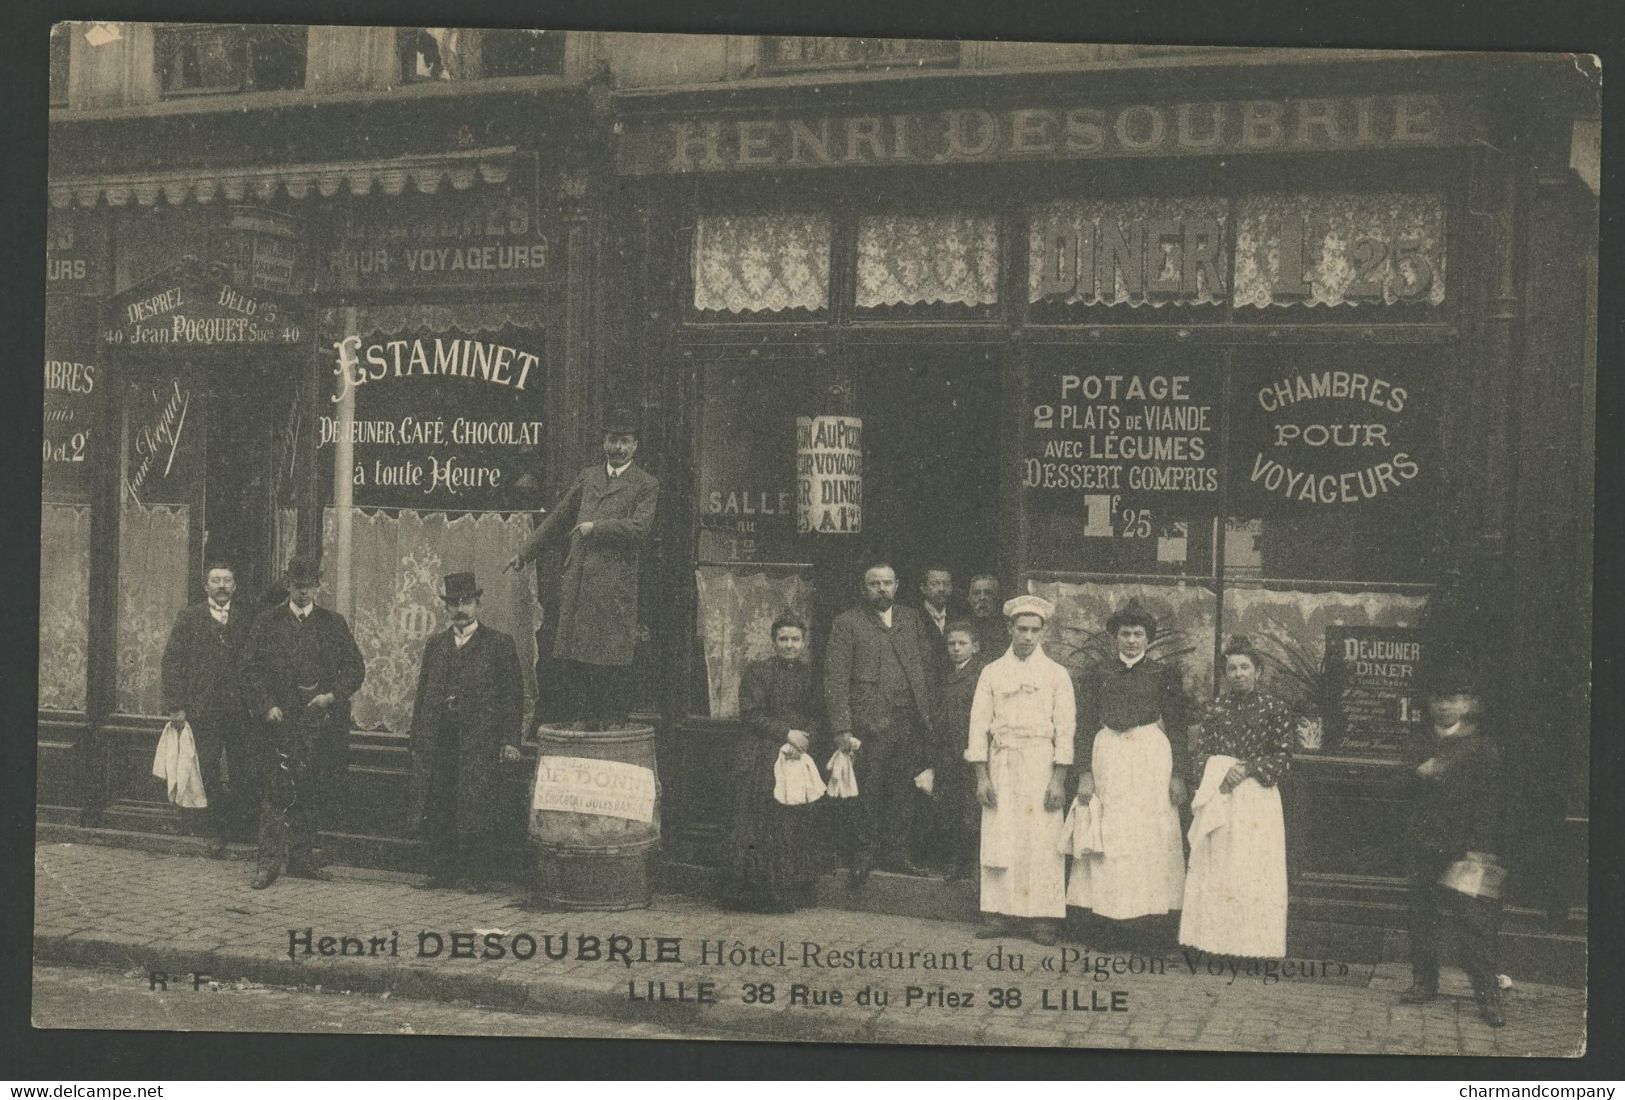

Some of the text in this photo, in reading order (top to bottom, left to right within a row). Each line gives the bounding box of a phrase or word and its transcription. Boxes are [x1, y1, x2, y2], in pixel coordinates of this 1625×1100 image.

[669, 94, 1439, 173] HENRI DESOUBRIE
[405, 245, 546, 272] VOYAGEURS
[1042, 212, 1230, 300] DINER
[127, 287, 184, 324] DESPREZ
[130, 325, 169, 344] Jean
[170, 314, 248, 346] POCQUET
[281, 327, 301, 342] 40
[331, 334, 540, 402] ESTAMINET
[1061, 375, 1190, 400] POTAGE
[1258, 371, 1408, 413] CHAMBRES
[451, 417, 543, 446] CHOCOLAT
[1034, 404, 1211, 431] 2 PLATS DE VIANDE
[1044, 431, 1205, 461] AVEC LÉGUMES
[1274, 423, 1391, 446] POUR
[375, 460, 423, 487] toute
[424, 456, 501, 495] Heure
[1023, 458, 1218, 491] DESSERT COMPRIS
[1251, 452, 1419, 503] VOYAGEURS
[708, 491, 790, 515] SALLE
[1355, 662, 1414, 678] DINER
